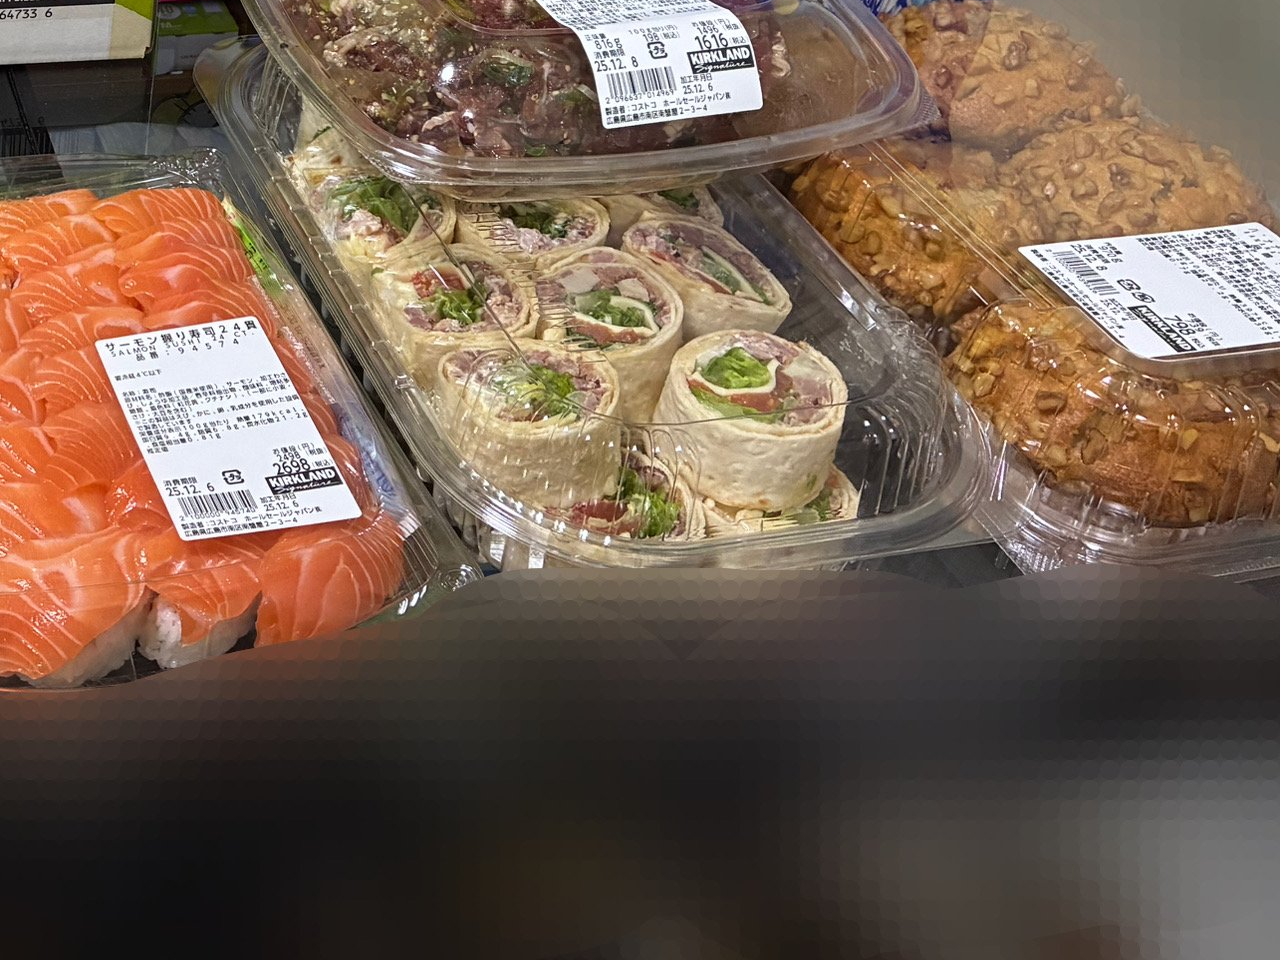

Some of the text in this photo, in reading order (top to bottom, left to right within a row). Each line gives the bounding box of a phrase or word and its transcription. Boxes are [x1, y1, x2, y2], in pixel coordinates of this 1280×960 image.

[0, 7, 38, 20] 64733
[44, 7, 54, 19] 6
[641, 32, 660, 42] 198
[697, 24, 719, 35] 1496
[695, 33, 729, 50] 1616
[593, 57, 627, 72] 25.12.
[689, 47, 750, 66] KIRKLAND
[1138, 306, 1193, 351] KIRKLAND
[1164, 315, 1196, 335] 798
[109, 344, 157, 357] SALMON
[163, 337, 202, 349] SUSHI
[210, 333, 226, 341] 24
[275, 451, 302, 462] 2498
[270, 457, 313, 475] 2698
[267, 467, 338, 488] KIRKLAND
[165, 483, 202, 498] 25.12.
[262, 500, 291, 512] 25.12.
